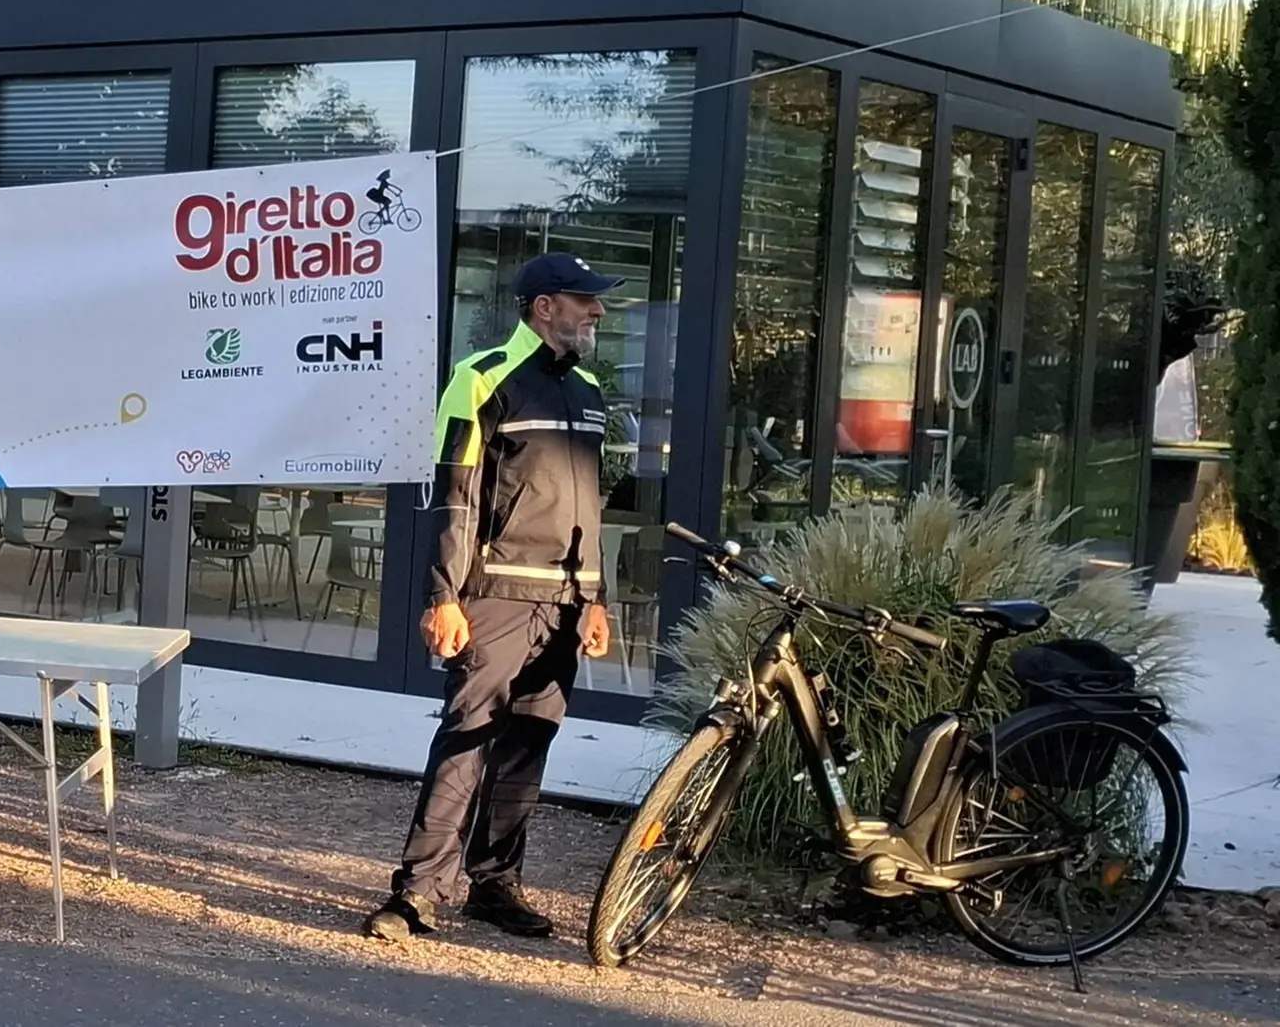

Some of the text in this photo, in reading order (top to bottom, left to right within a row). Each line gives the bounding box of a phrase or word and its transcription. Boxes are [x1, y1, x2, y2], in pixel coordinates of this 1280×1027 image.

[175, 185, 355, 271] giretto
[190, 280, 384, 310] bike to work edizione 2020
[955, 343, 979, 372] LAB
[181, 366, 264, 380] LEGAMBIENTE
[297, 363, 384, 374] INDUSTRIAL
[205, 449, 231, 462] velo
[284, 458, 383, 475] Euromobility
